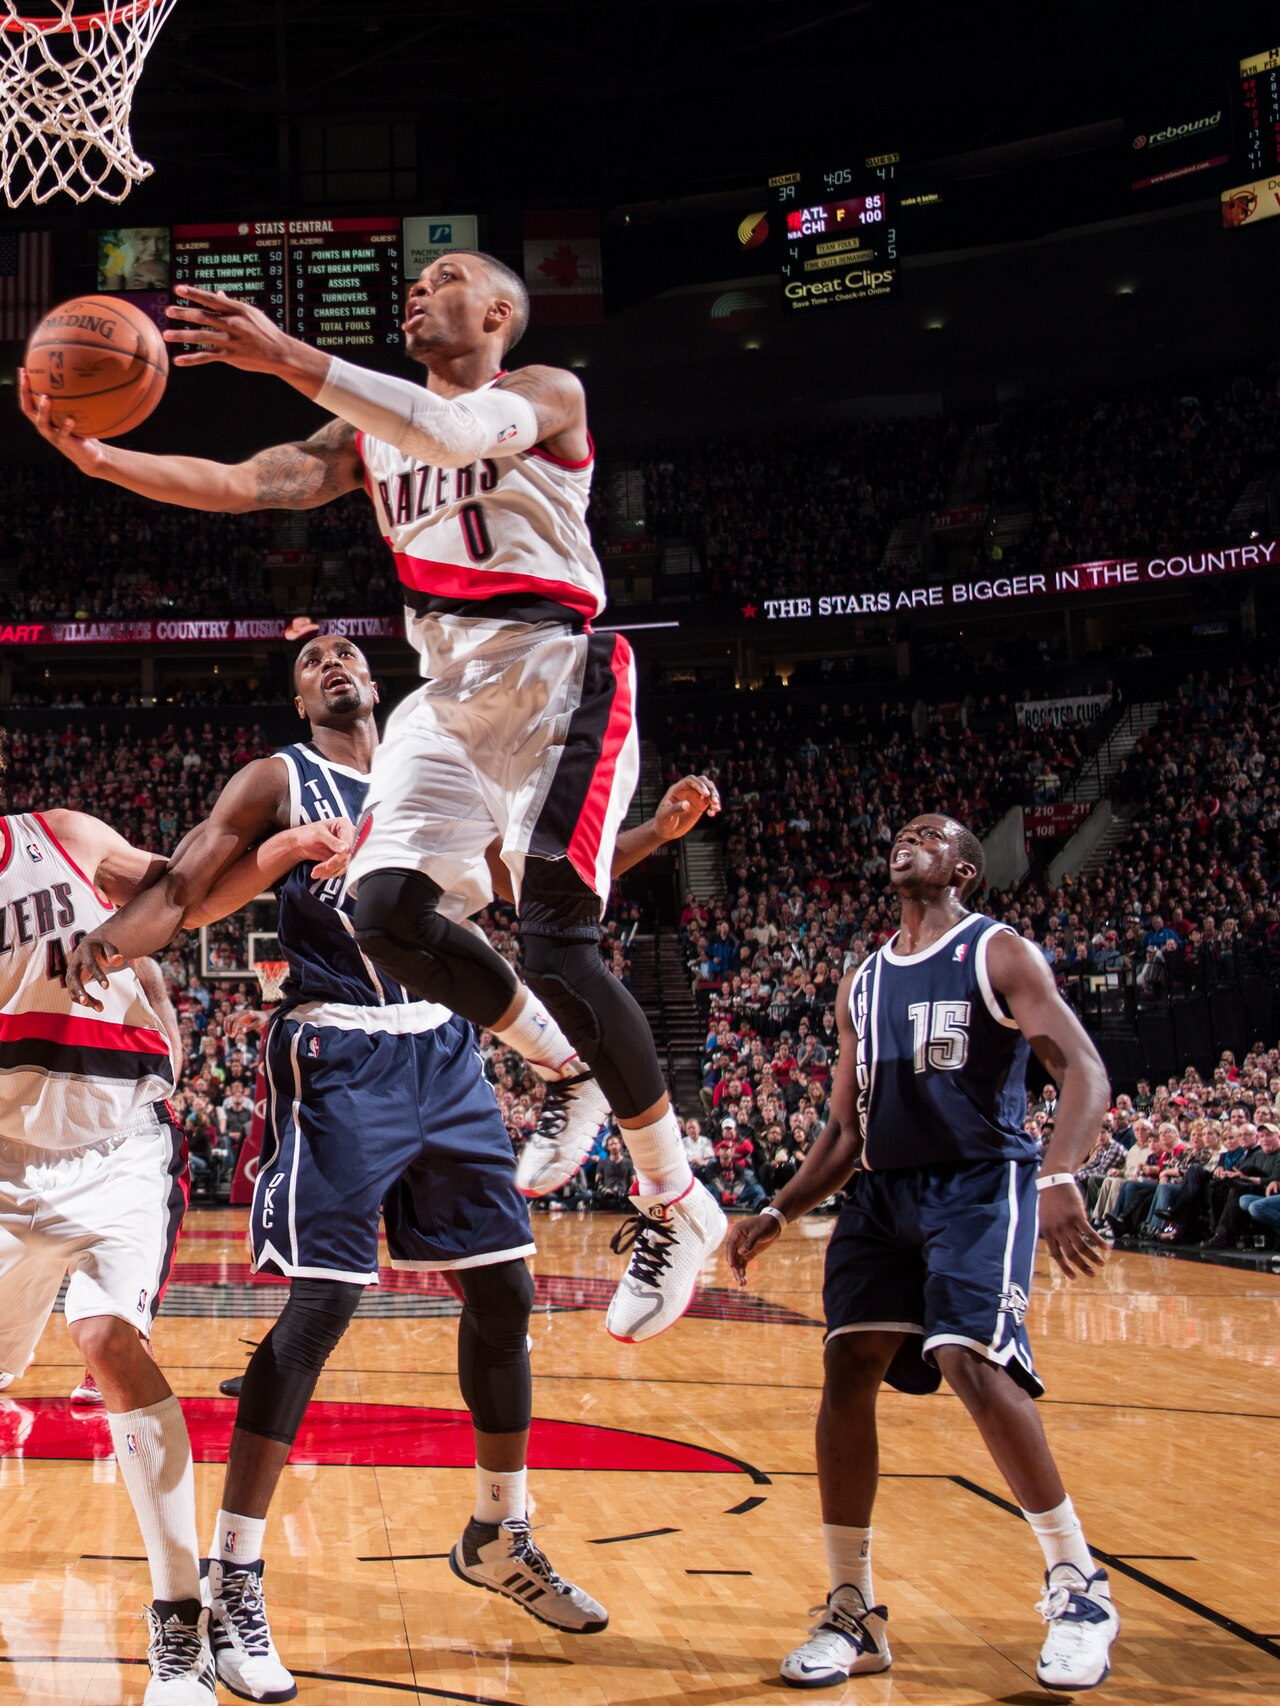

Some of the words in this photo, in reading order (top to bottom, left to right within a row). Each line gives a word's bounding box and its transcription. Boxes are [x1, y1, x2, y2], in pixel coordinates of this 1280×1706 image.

[1242, 66, 1258, 77] PLYR
[1264, 58, 1277, 70] PTS
[1148, 110, 1222, 144] rebound
[771, 174, 798, 186] HOME
[824, 169, 852, 185] 4:05
[779, 186, 796, 201] 39
[876, 166, 894, 180] 41
[801, 207, 828, 222] ATL
[836, 209, 846, 222] F
[865, 195, 882, 208] 85
[254, 222, 285, 235] STATS
[289, 221, 334, 234] CENTRAL
[802, 222, 826, 235] CHI
[859, 209, 882, 224] 100
[788, 232, 803, 240] NBA
[888, 228, 896, 244] 3
[176, 242, 210, 250] BLAZERS
[256, 239, 282, 247] GUEST
[410, 248, 441, 256] PACIFIC
[790, 247, 798, 259] 4
[818, 242, 836, 252] TEAM
[888, 245, 896, 259] 5
[197, 255, 220, 264] FIELD
[221, 254, 242, 264] GOAL
[243, 254, 261, 262] PCT.
[311, 250, 340, 260] POINTS
[342, 250, 350, 258] IN
[352, 249, 376, 258] PAINT
[194, 270, 214, 278] FREE
[216, 268, 244, 278] THROW
[246, 268, 264, 277] PCT.
[308, 265, 326, 274] FAST
[328, 264, 352, 274] BREAK
[353, 263, 380, 273] POINTS
[782, 264, 790, 276] 4
[214, 282, 243, 292] THROWS
[244, 282, 264, 291] MADE
[328, 278, 361, 288] ASSISTS
[784, 279, 842, 298] Great
[845, 270, 893, 288] Clips
[322, 292, 368, 302] TURNOVERS
[792, 300, 810, 309] Save
[812, 298, 828, 306] Time
[834, 290, 866, 302] Check-in
[868, 286, 890, 296] Online
[314, 308, 350, 318] CHARGES
[352, 306, 376, 316] TAKEN
[320, 322, 343, 331] TOTAL
[345, 321, 370, 330] FOULS
[316, 336, 343, 346] BENCH
[346, 335, 374, 345] POINTS
[458, 502, 496, 563] 0
[764, 598, 811, 619] THE
[818, 592, 891, 616] STARS
[895, 586, 944, 610] ARE
[952, 574, 1046, 604] BIGGER
[1056, 570, 1080, 590] IN
[1086, 562, 1139, 586] THE
[1148, 541, 1276, 579] COUNTRY
[156, 620, 229, 640] COUNTRY
[234, 620, 286, 639] MUSIC
[319, 618, 393, 638] FESTIVAL
[1076, 702, 1101, 722] CLUB
[1034, 805, 1054, 818] 210
[1072, 802, 1091, 815] 211
[1035, 824, 1056, 836] 108
[908, 1000, 972, 1074] 15
[262, 1172, 285, 1230] OKC
